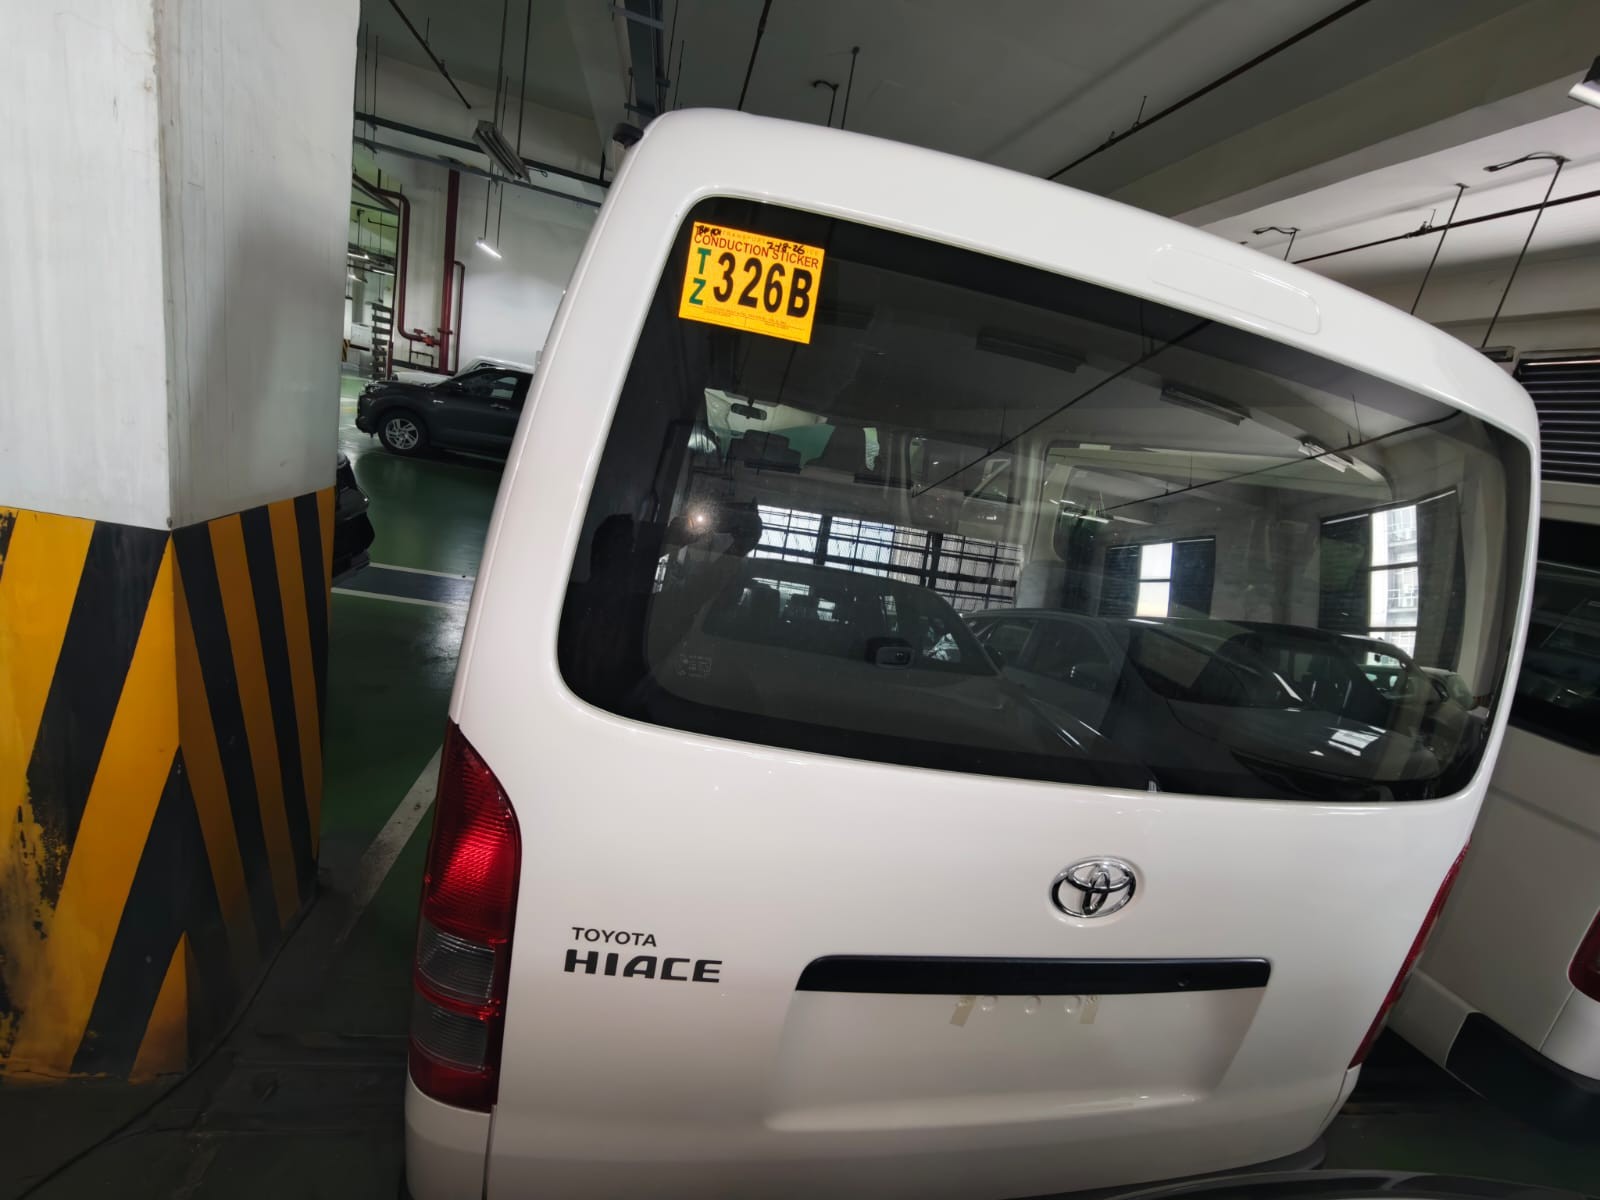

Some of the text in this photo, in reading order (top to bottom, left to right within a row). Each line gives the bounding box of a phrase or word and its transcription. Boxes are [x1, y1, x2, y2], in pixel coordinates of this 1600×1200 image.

[694, 233, 769, 258] CONDUCTION
[772, 250, 819, 270] STICKER
[713, 251, 813, 319] 326B
[572, 927, 657, 947] TOYOTA
[564, 949, 723, 983] HIACE
